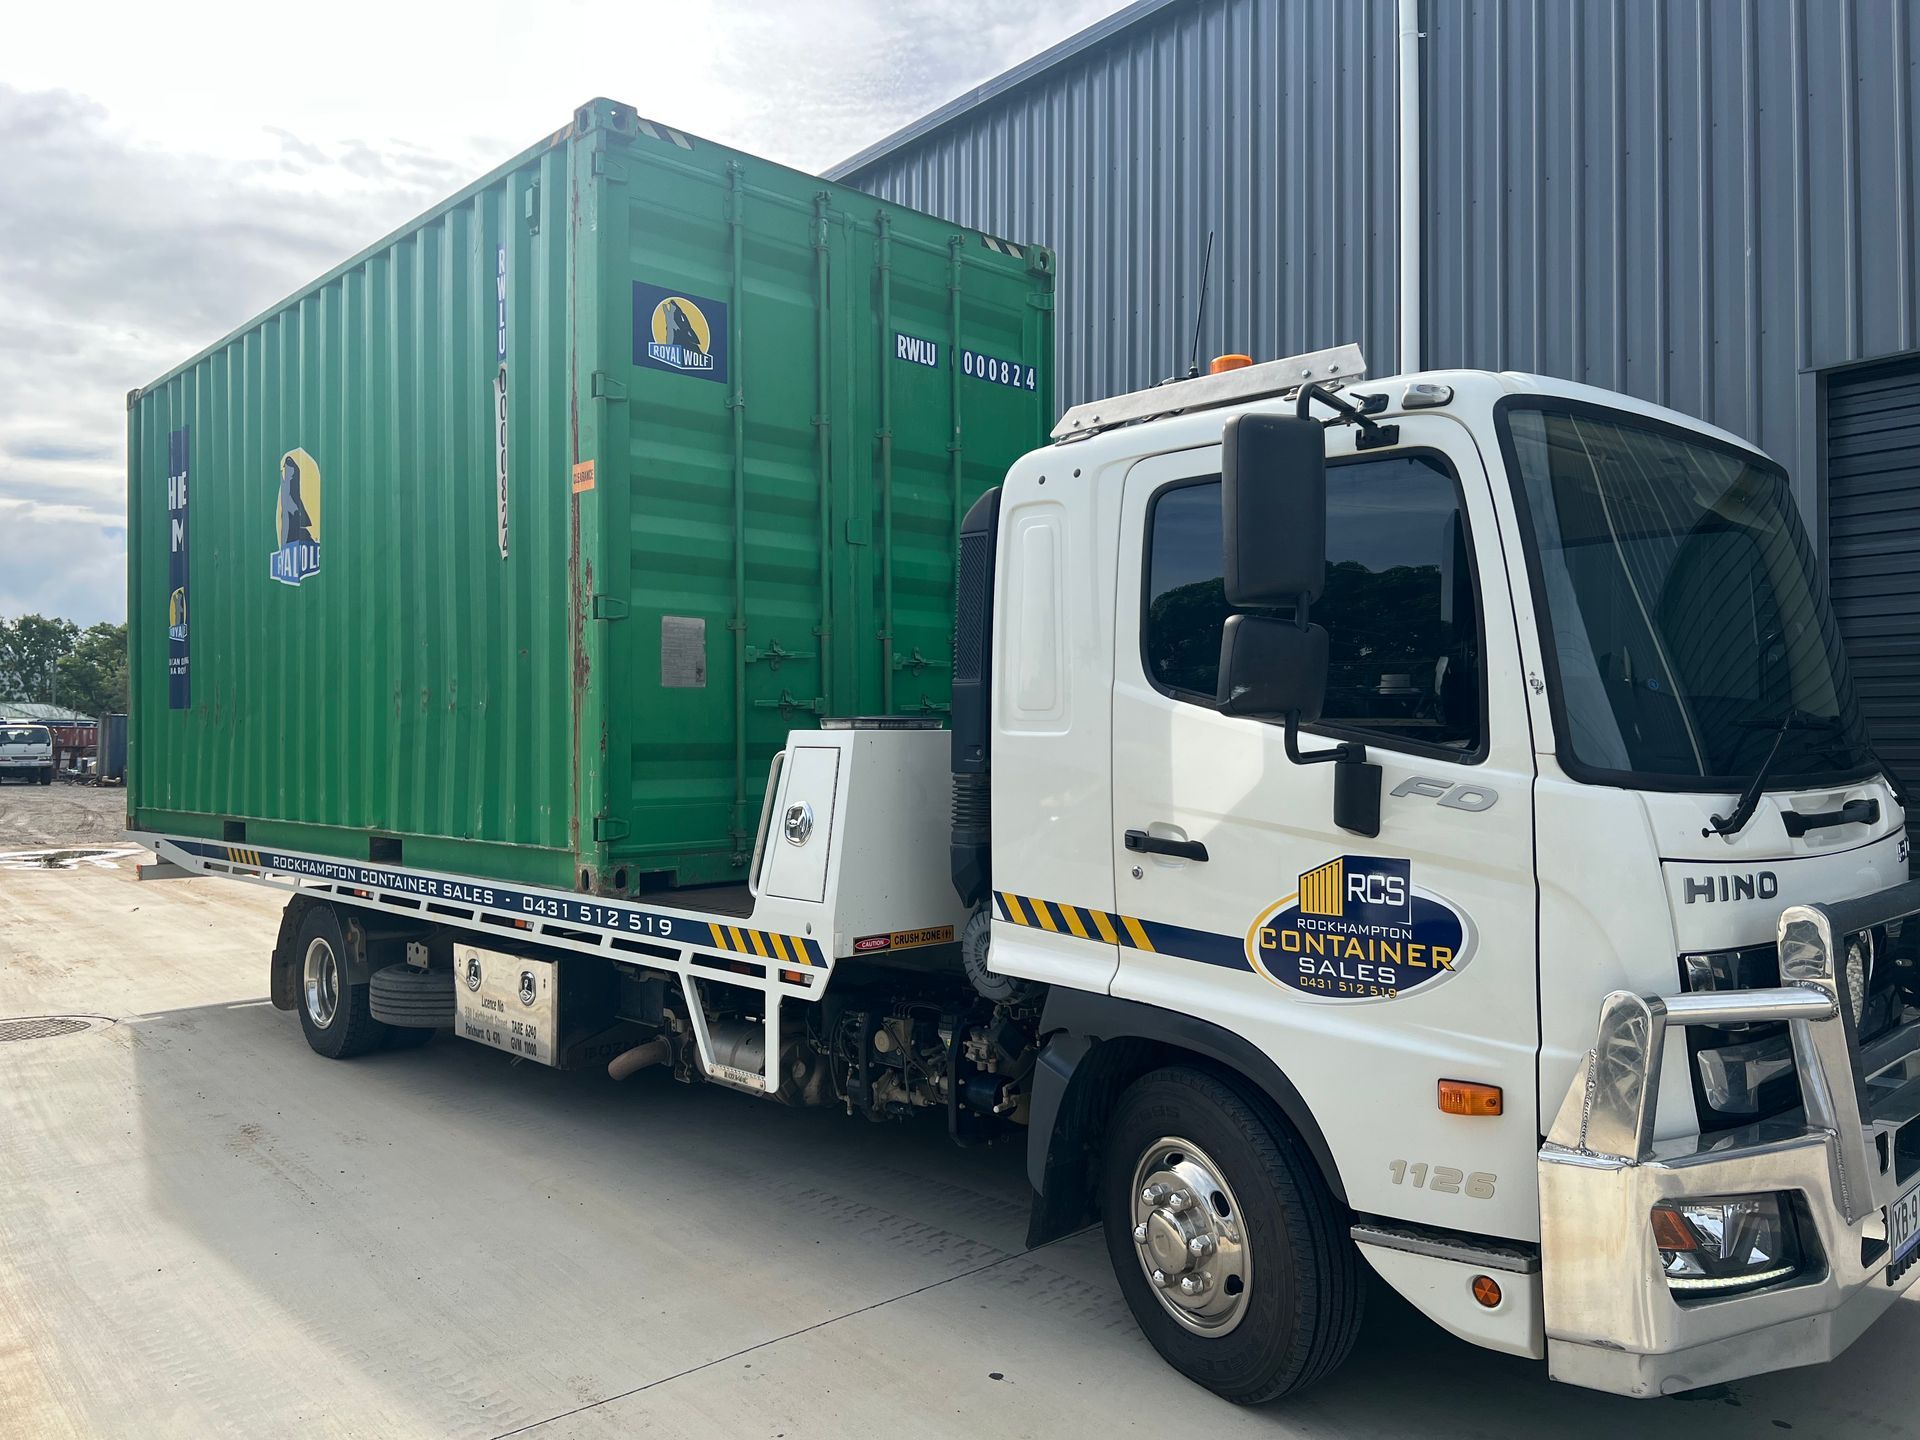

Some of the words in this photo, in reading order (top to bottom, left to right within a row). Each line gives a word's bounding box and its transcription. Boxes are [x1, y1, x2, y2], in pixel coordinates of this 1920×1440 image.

[653, 345, 681, 364] ROYAL
[683, 348, 709, 367] WOLF
[897, 334, 936, 366] RWLU
[951, 349, 1035, 390] 000824
[300, 545, 320, 571] OLF
[1389, 775, 1499, 813] FD
[273, 855, 356, 881] ROCKHAMPTON
[360, 869, 437, 895] CONTAINER
[443, 883, 494, 905] SALES
[523, 896, 568, 919] 0431
[580, 906, 619, 927] 512
[629, 913, 672, 936] 519
[1347, 873, 1405, 906] RCS
[1683, 870, 1778, 904] HINO
[861, 939, 884, 948] CAUTION
[894, 932, 920, 945] CRUSH
[921, 930, 941, 941] ZONE
[1297, 918, 1413, 940] ROCKHAMPTON
[1260, 927, 1455, 971] CONTAINER
[1299, 957, 1396, 984] SALES
[1300, 976, 1332, 990] 0431
[1339, 983, 1365, 994] 512
[1370, 985, 1398, 999] 519
[1389, 1159, 1497, 1200] 1126
